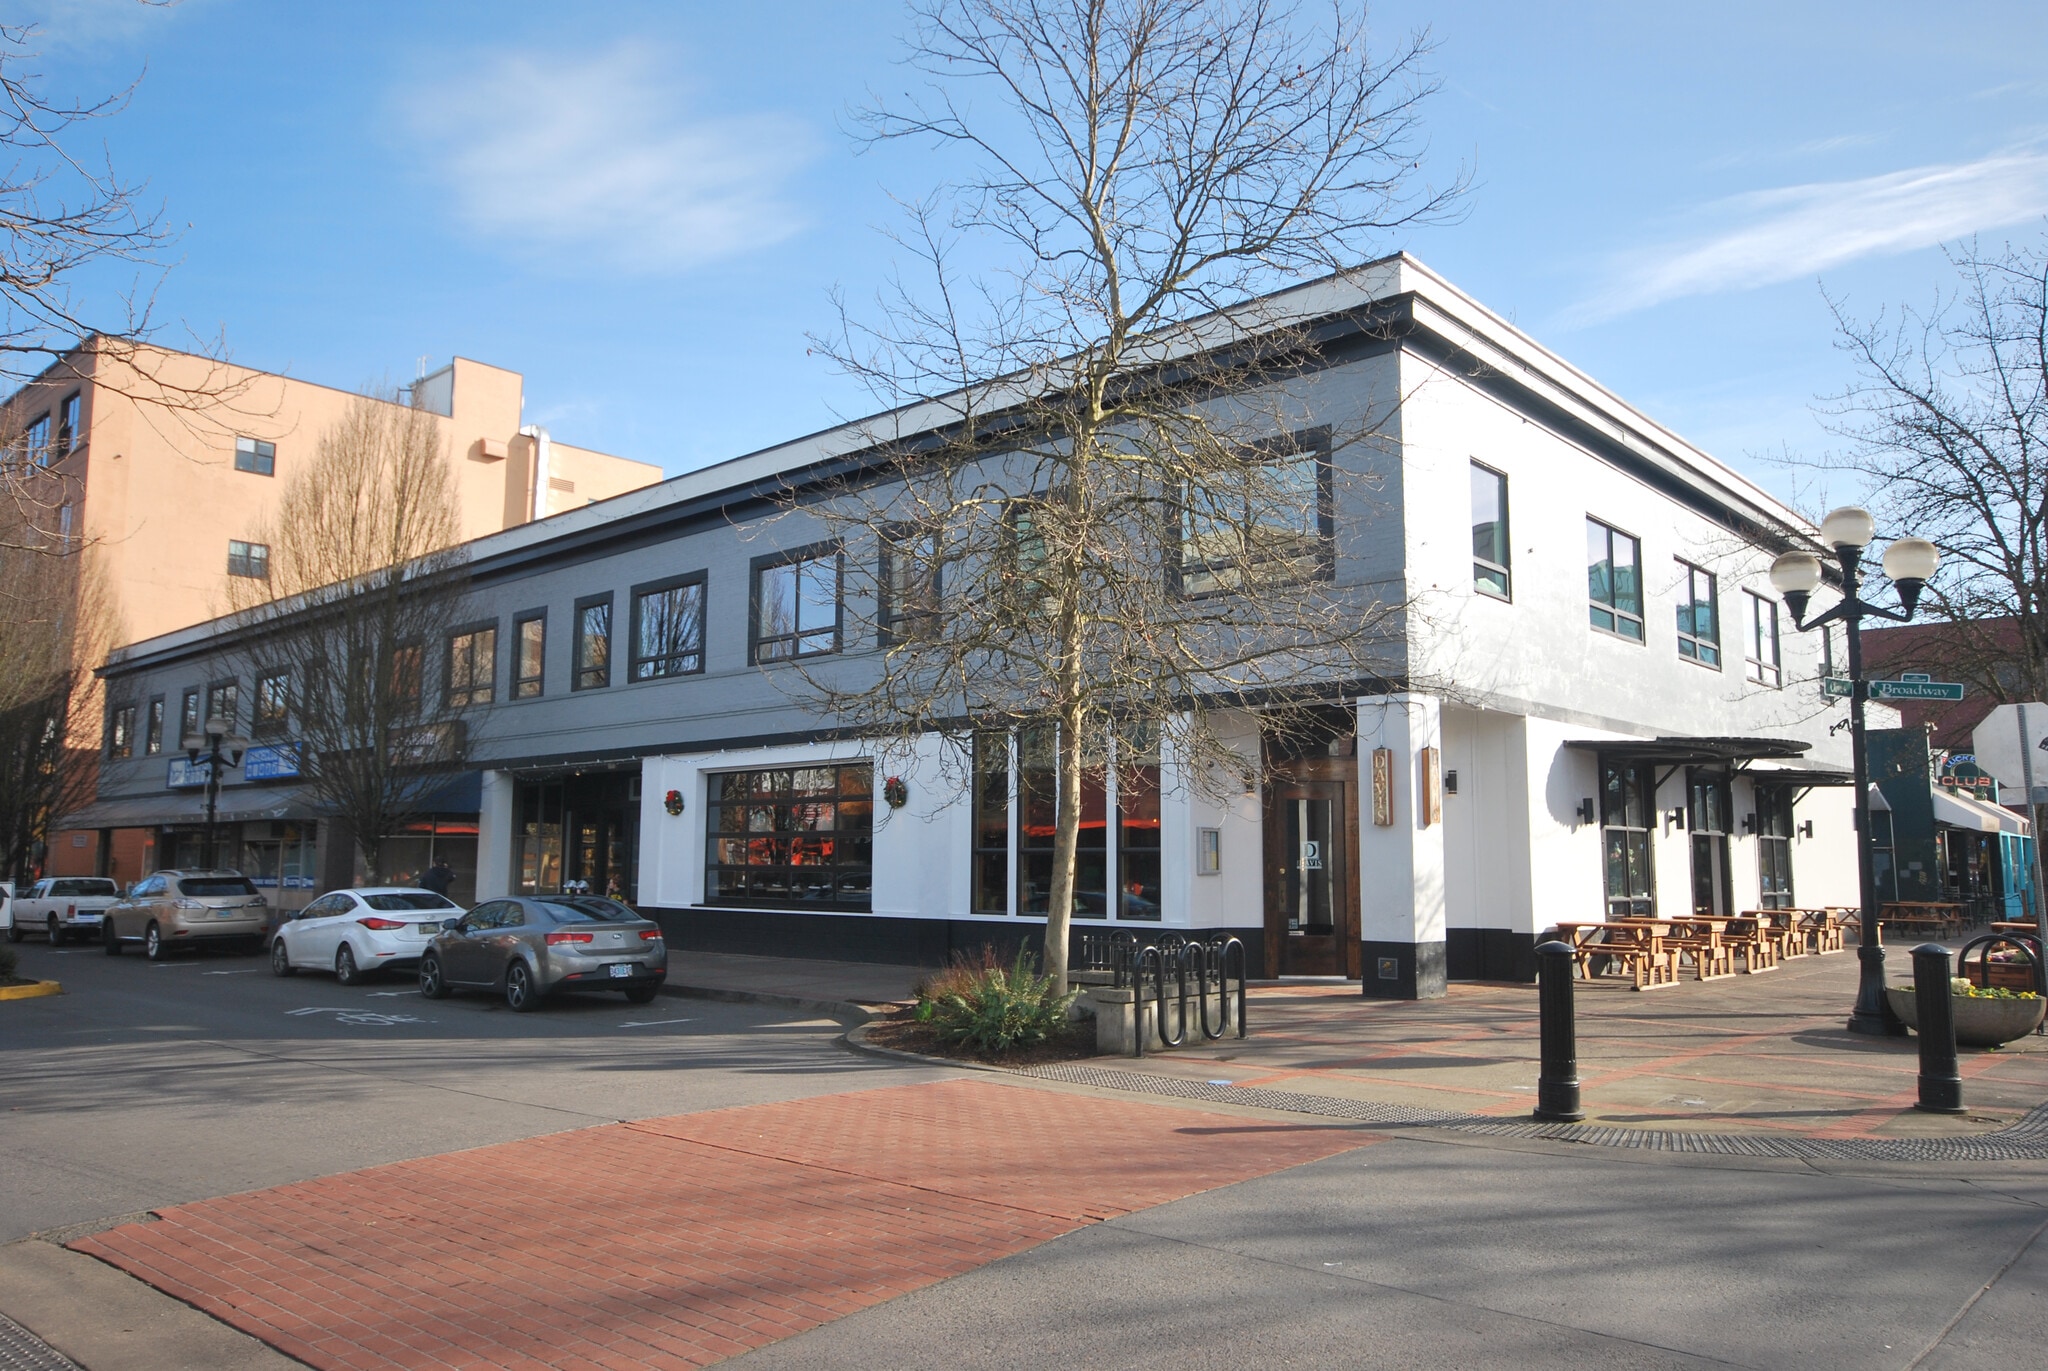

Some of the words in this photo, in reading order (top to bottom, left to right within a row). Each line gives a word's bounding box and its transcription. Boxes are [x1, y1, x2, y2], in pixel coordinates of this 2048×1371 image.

[1882, 683, 1949, 697] Broadway
[1942, 776, 1991, 787] CLUB
[1375, 756, 1385, 823] DAVIS
